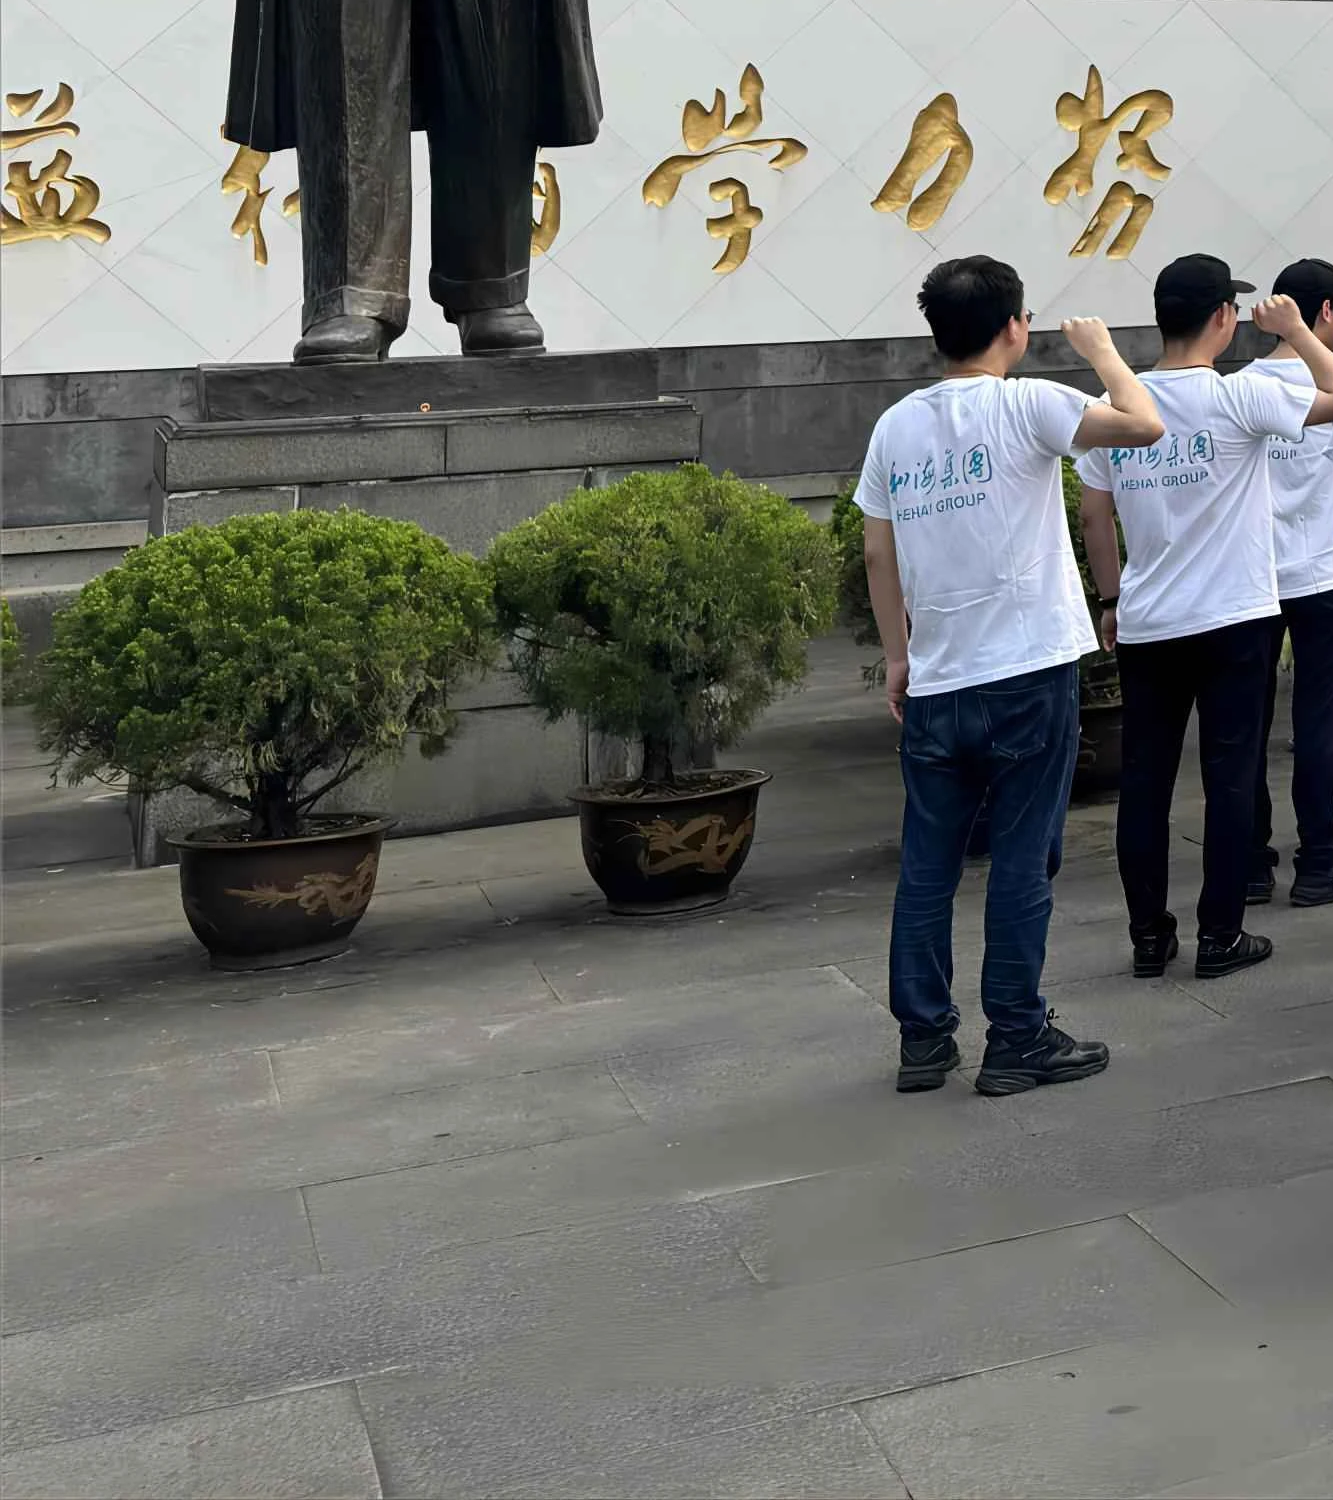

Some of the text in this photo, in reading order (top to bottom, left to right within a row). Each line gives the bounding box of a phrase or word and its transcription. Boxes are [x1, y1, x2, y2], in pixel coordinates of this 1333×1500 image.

[1120, 470, 1209, 491] HEHAI GROUP
[895, 491, 987, 523] HEHAI GROUP
